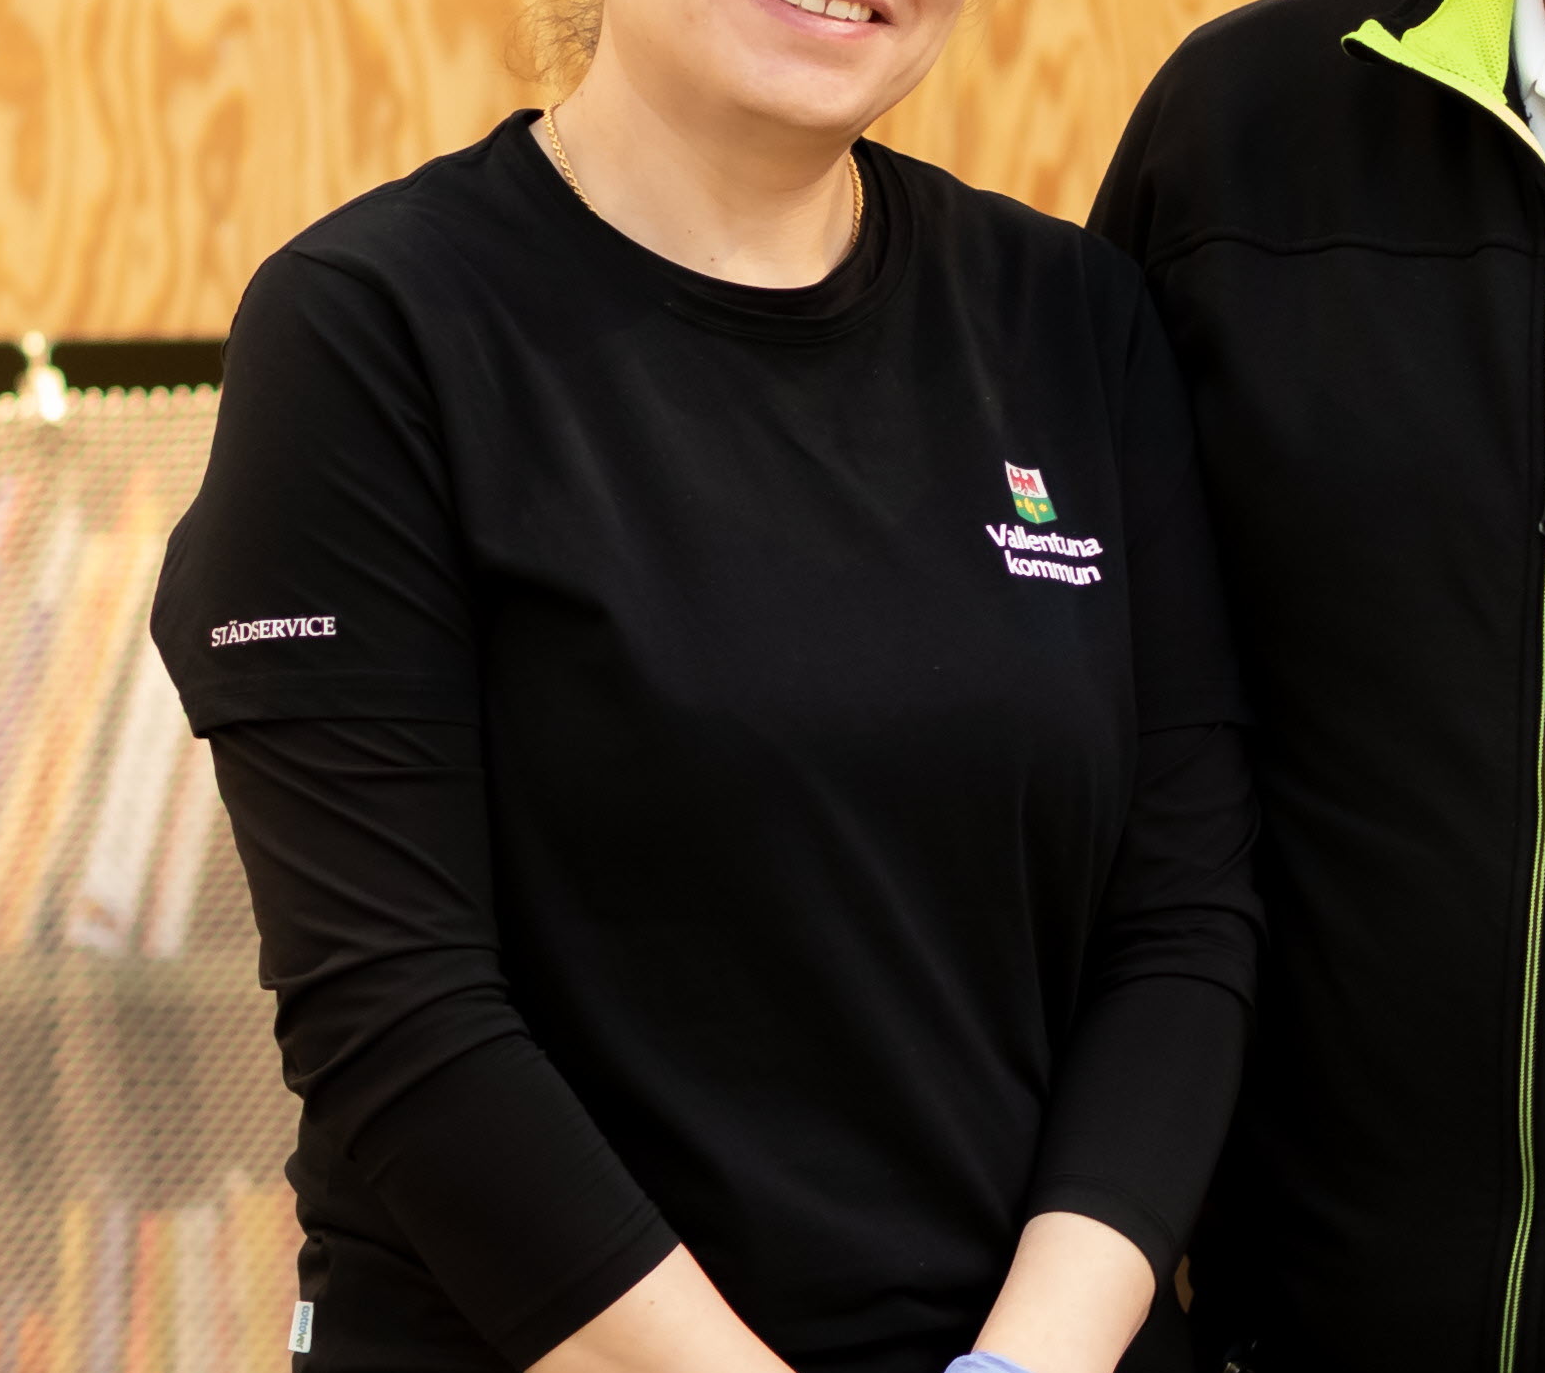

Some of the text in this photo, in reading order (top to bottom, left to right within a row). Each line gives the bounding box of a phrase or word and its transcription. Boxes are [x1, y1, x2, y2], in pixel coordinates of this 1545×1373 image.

[986, 524, 1103, 557] Vallentuna
[1004, 550, 1101, 585] kommun
[211, 616, 337, 647] STÄDSERVICE
